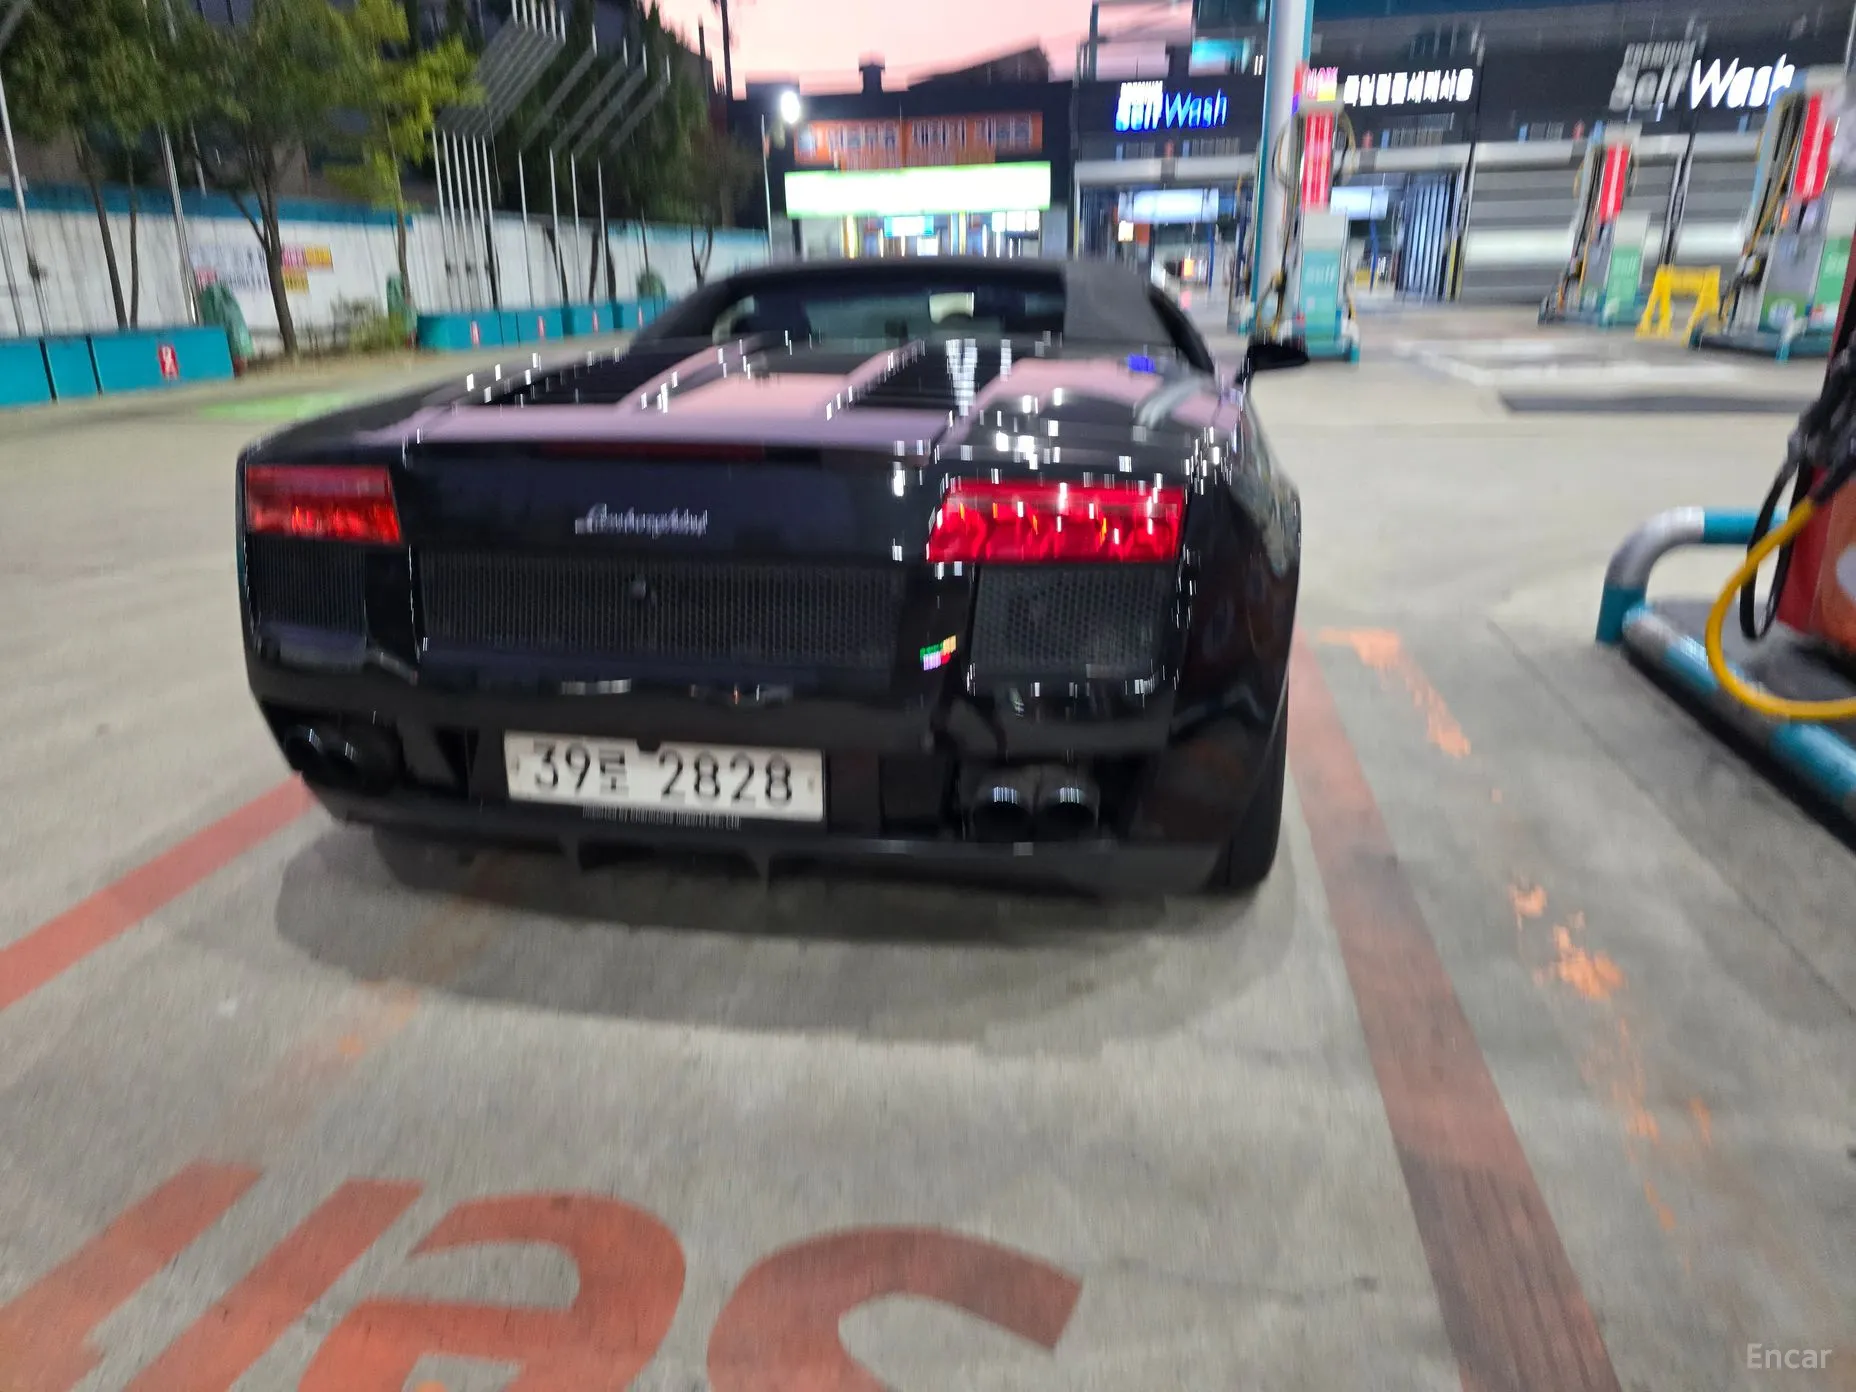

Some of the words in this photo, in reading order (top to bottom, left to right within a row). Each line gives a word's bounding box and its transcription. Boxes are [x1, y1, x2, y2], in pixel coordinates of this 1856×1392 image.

[1165, 88, 1227, 128] Wash
[1691, 53, 1795, 110] Wash
[659, 750, 793, 808] 2828
